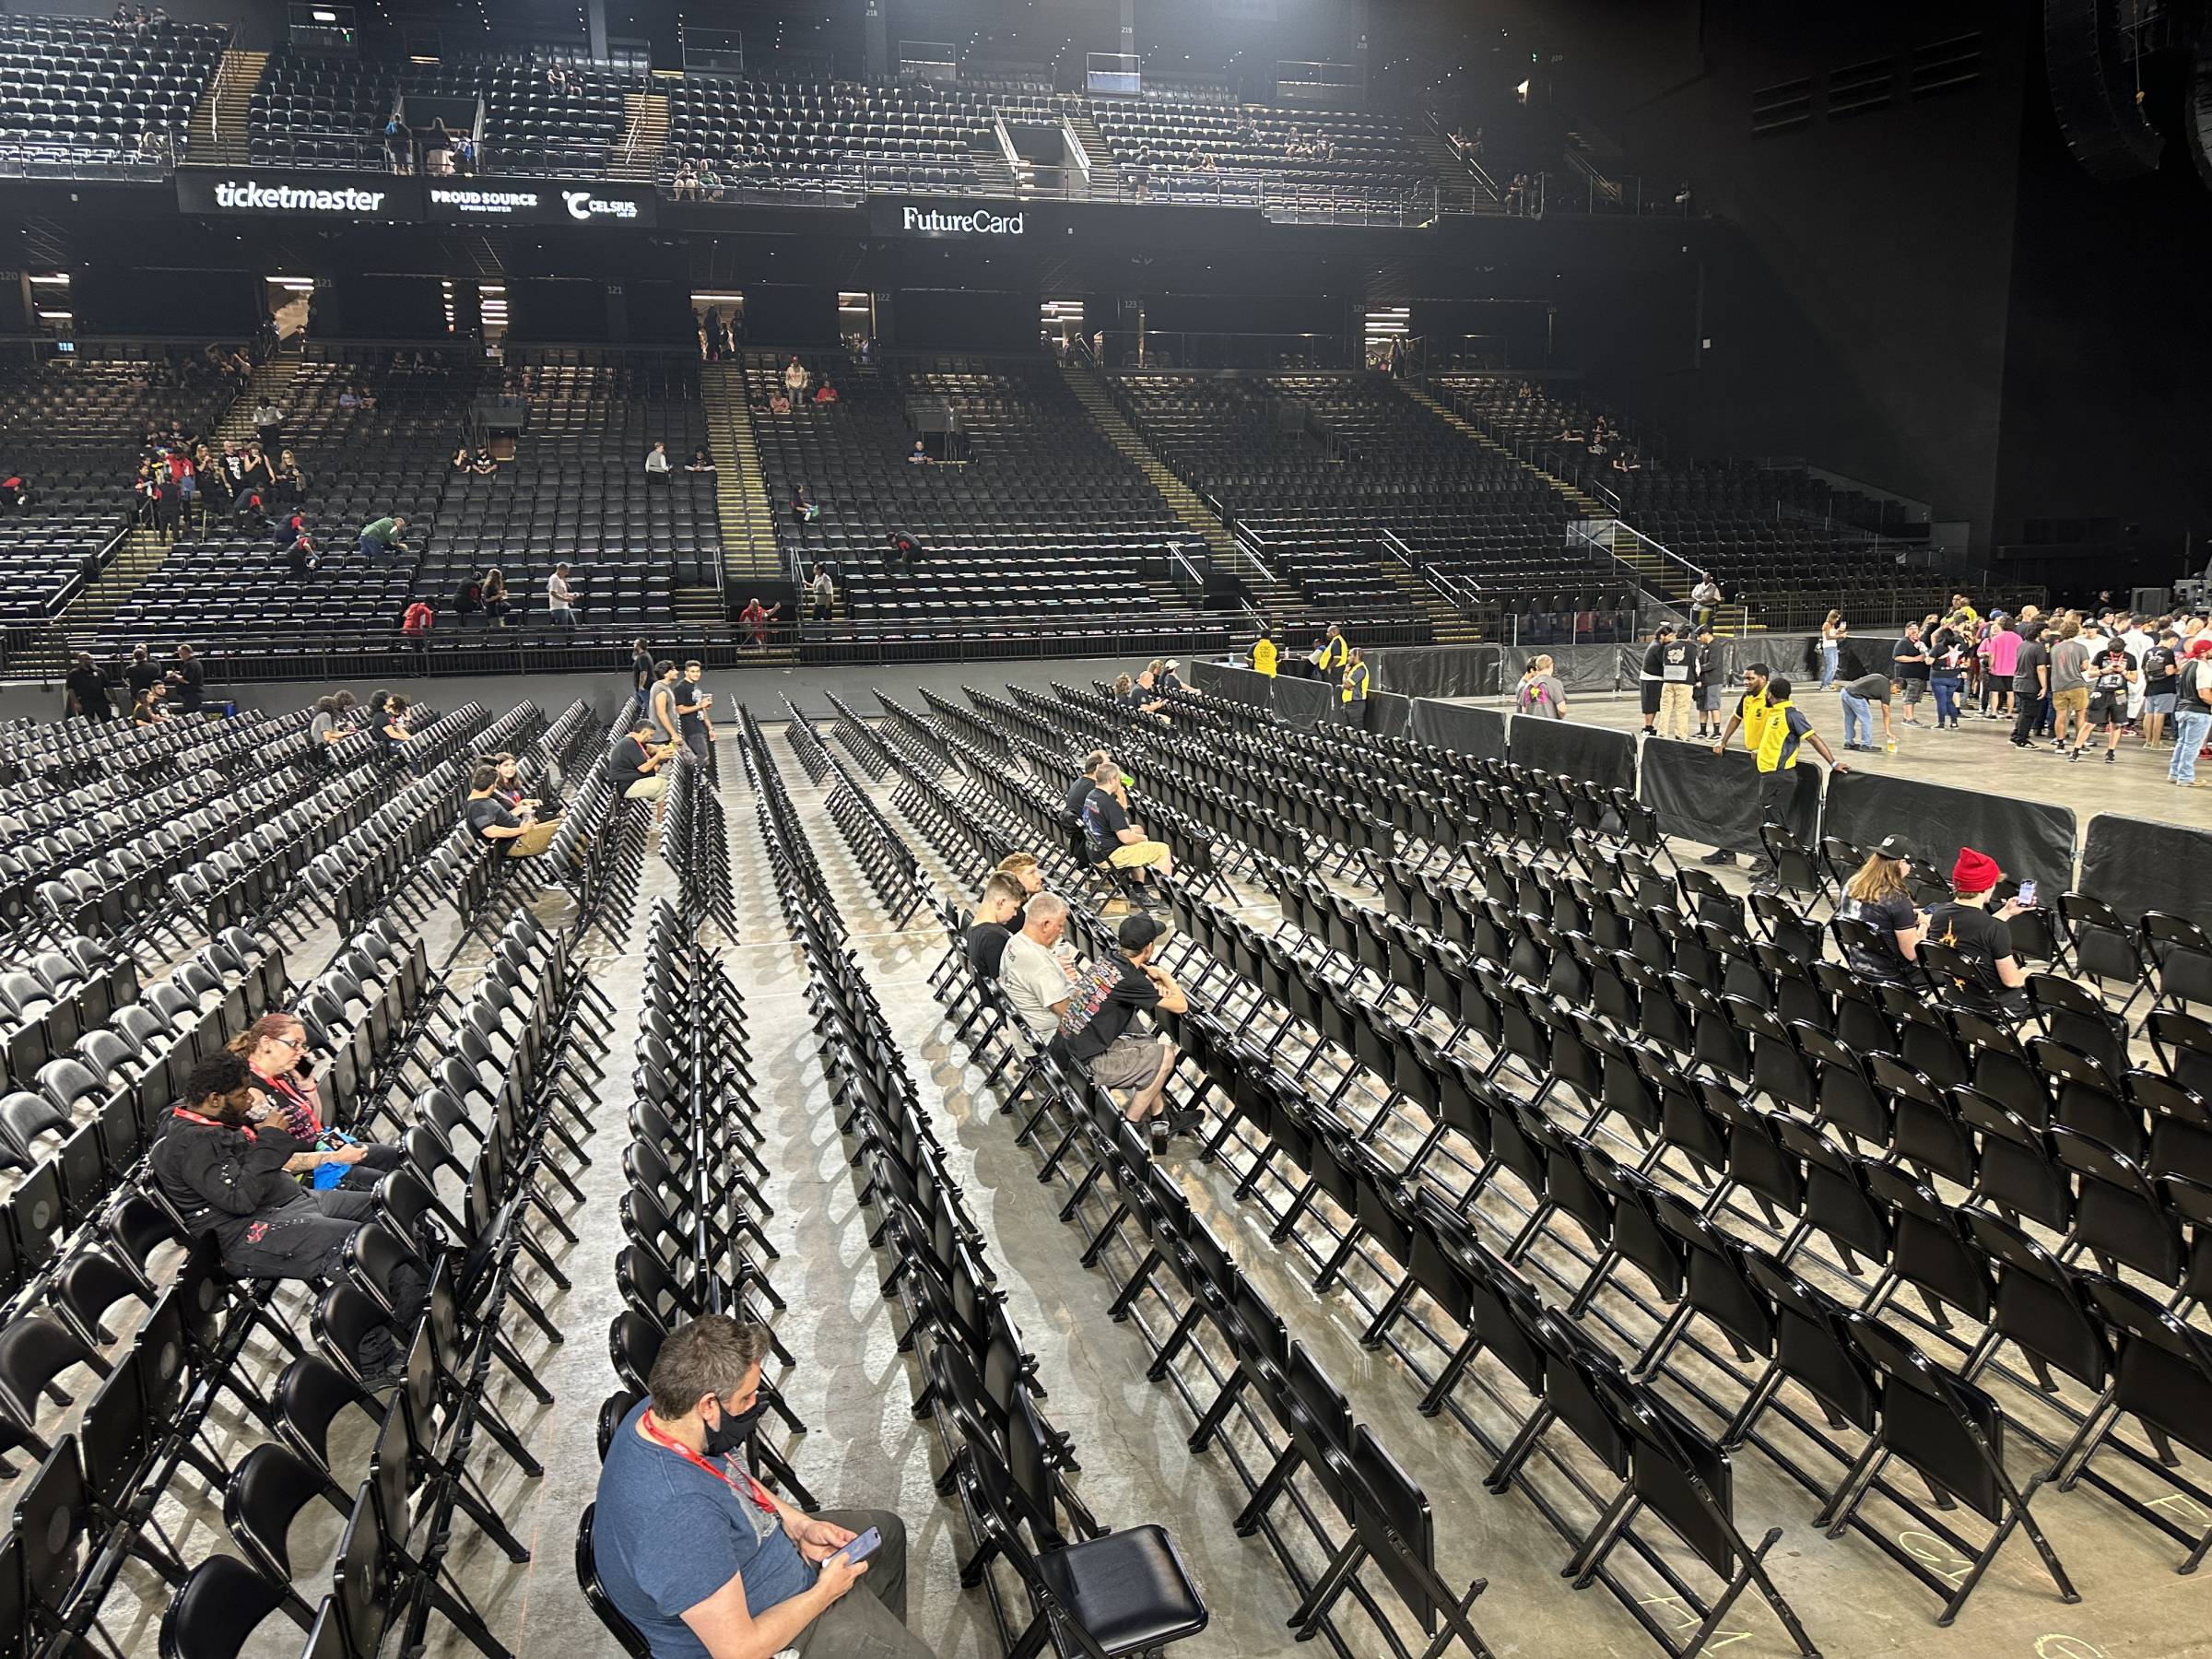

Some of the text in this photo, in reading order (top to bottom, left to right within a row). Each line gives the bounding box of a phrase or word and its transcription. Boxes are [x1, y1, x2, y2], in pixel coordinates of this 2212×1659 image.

[215, 181, 384, 210] ticketmaster
[430, 190, 538, 206] PROUD SOURCE
[588, 200, 638, 214] CELSIUS
[902, 206, 1024, 234] FutureCard
